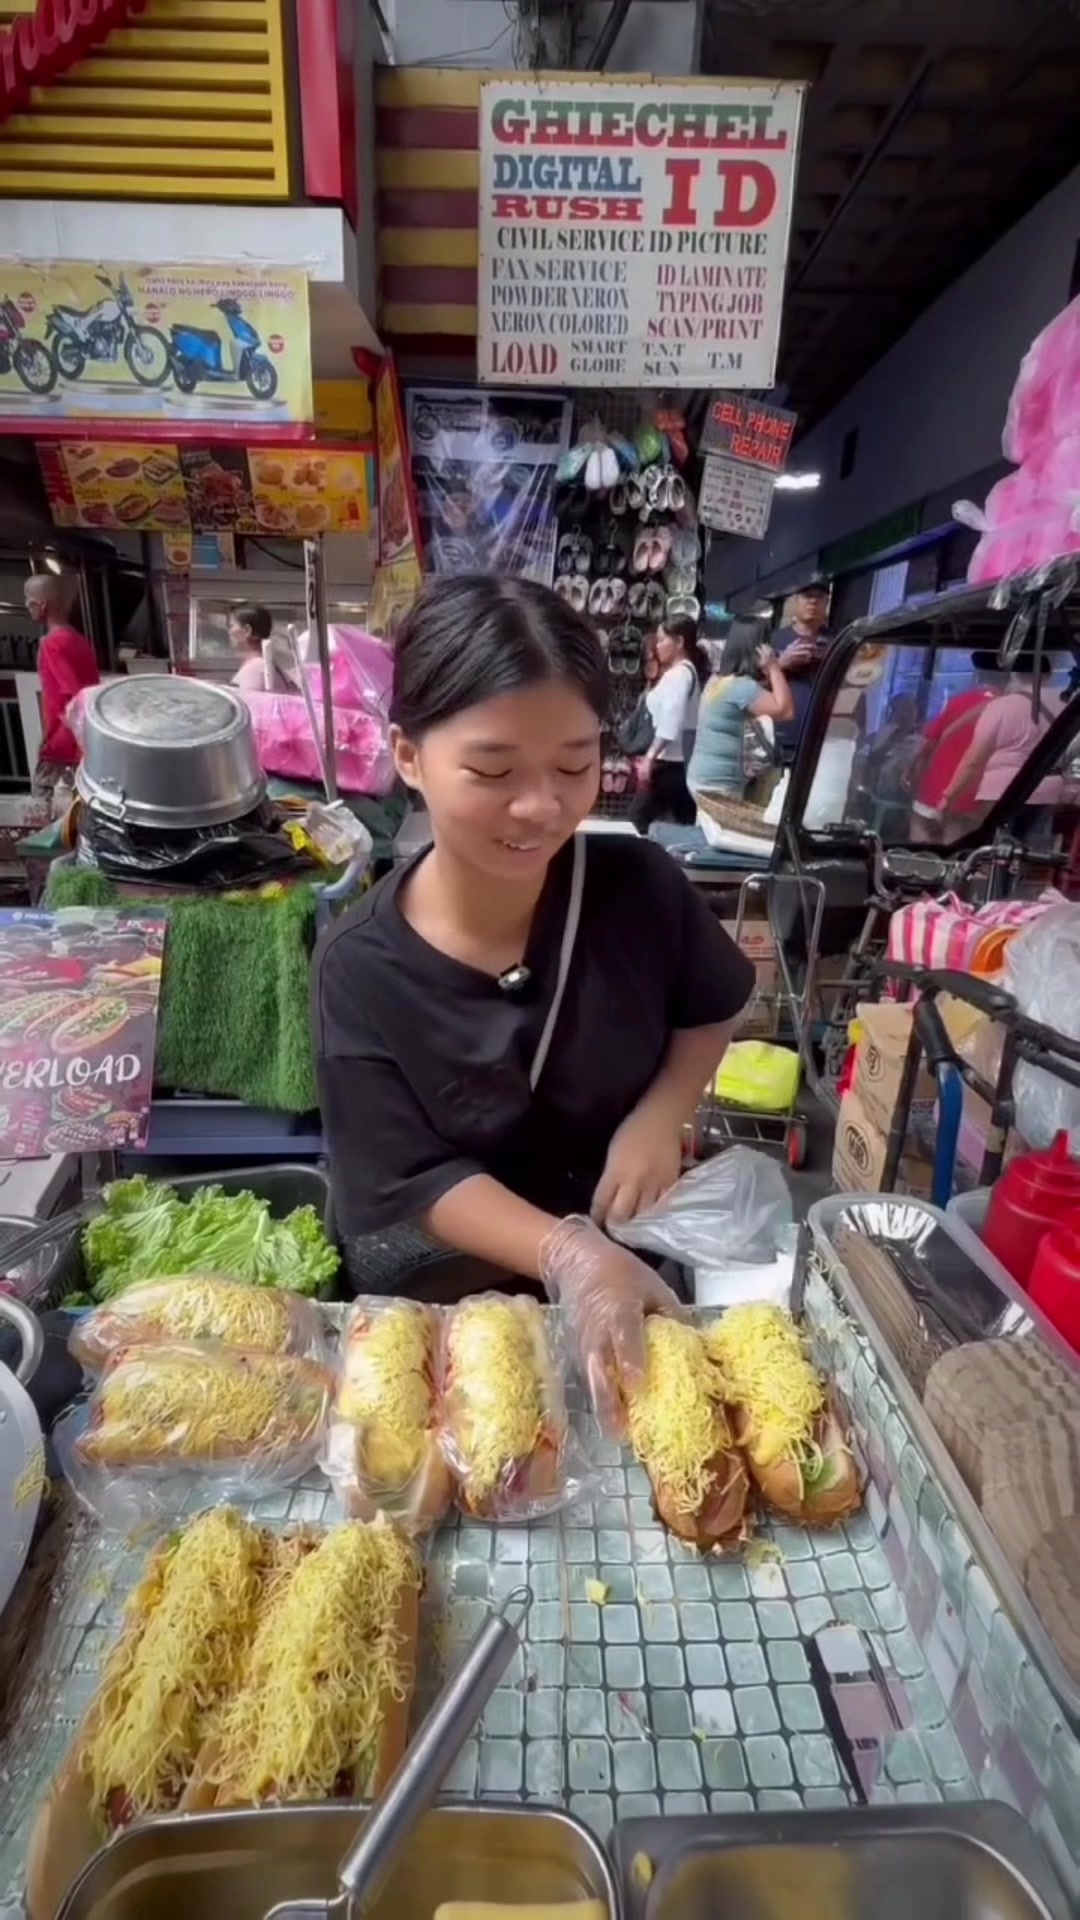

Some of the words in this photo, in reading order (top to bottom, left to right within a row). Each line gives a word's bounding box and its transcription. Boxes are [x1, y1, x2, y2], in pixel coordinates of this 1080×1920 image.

[491, 98, 787, 150] GHIECHEL
[493, 154, 642, 192] DIGITAL
[662, 158, 777, 226] ID
[491, 194, 643, 221] RUSH
[497, 227, 552, 250] CIVIL
[557, 229, 644, 252] SERVICE
[649, 231, 673, 253] ID
[678, 231, 767, 255] PICTURE
[491, 258, 529, 280] FAX
[534, 260, 627, 282] SERVICE
[657, 264, 677, 286] ID
[680, 265, 767, 289] LAMINATE
[491, 286, 570, 307] POWDER
[572, 287, 629, 309] XEROX
[656, 291, 725, 314] TYPING
[726, 292, 763, 314] JOB
[491, 312, 546, 334] XEROX
[549, 313, 628, 336] COLORED
[647, 317, 763, 340] SCAN/PRINT
[491, 342, 557, 374] LOAD
[570, 340, 628, 355] SMART
[570, 358, 626, 374] GLOBE
[643, 361, 680, 376] SUN
[712, 401, 742, 427] CELL
[746, 411, 791, 440] PHONE
[730, 433, 782, 464] REPAIR
